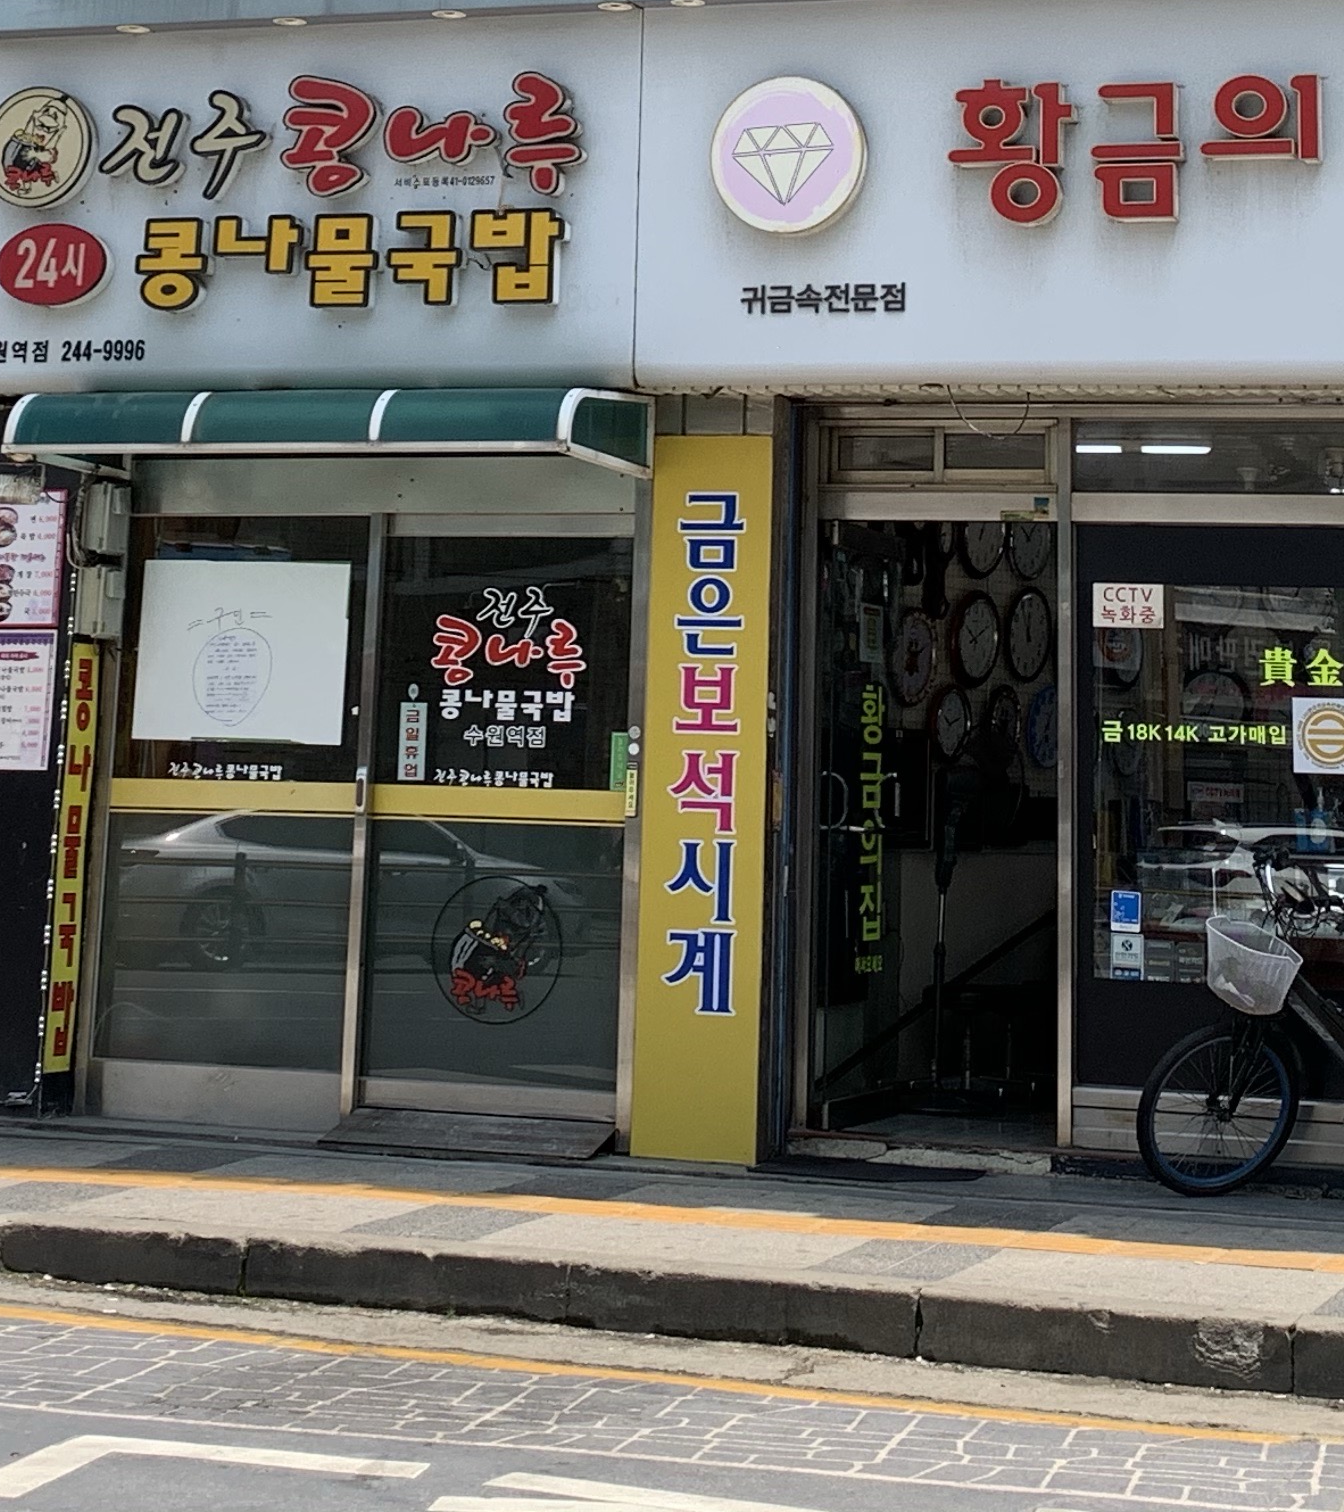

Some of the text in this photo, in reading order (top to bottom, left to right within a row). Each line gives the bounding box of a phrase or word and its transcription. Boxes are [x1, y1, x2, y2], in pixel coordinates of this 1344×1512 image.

[14, 207, 568, 312] 24시 콩나물국밥
[739, 282, 908, 316] 귀금속전문점
[60, 338, 146, 364] 244-9996
[1103, 587, 1154, 603] CCTV
[1100, 605, 1157, 624] 녹화중
[439, 689, 576, 722] 콩나물국밥
[462, 723, 548, 749] 수원역점
[1207, 725, 1287, 746] 고가매입
